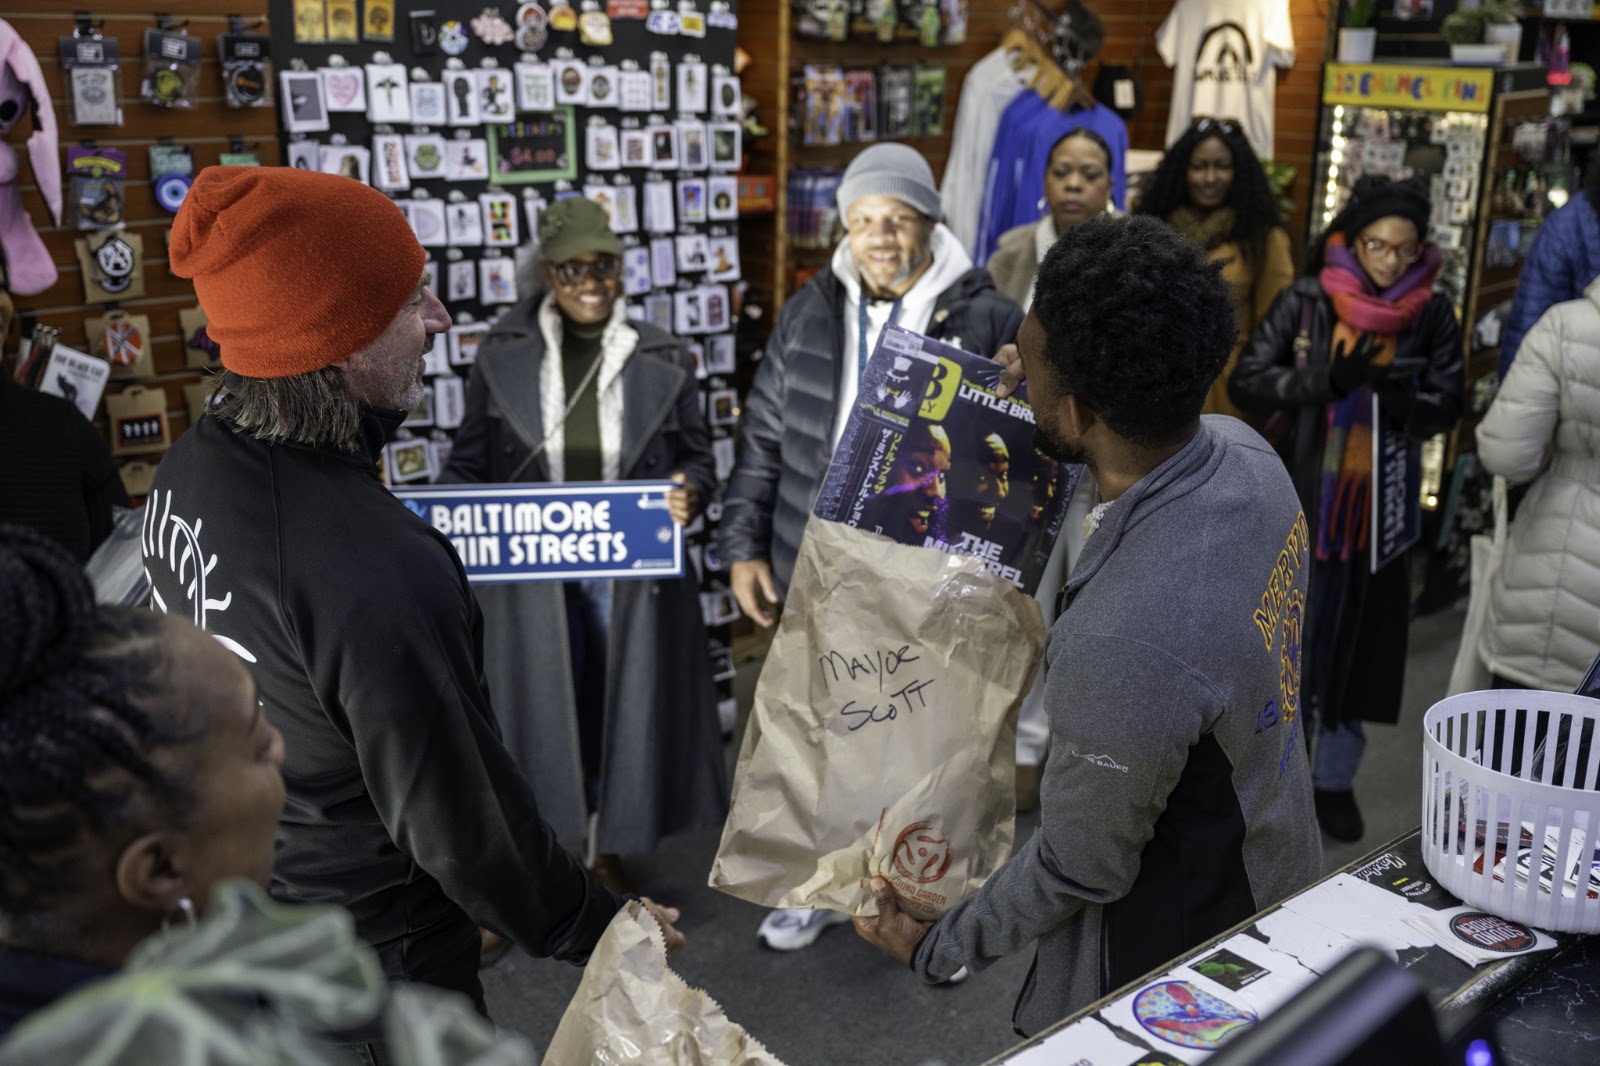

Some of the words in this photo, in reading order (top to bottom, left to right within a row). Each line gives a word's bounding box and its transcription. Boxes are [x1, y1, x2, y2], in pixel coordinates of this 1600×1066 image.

[1359, 73, 1434, 100] ENAMEL
[959, 384, 1010, 414] LITTLE
[431, 500, 610, 534] BALTIMORE
[450, 535, 501, 567] AIN
[508, 532, 628, 566] STREETS
[961, 531, 1004, 561] THE
[819, 645, 920, 693] MAYOR
[840, 678, 936, 731] SCOTT
[916, 888, 948, 905] GARDEN
[1473, 925, 1526, 946] SOUND
